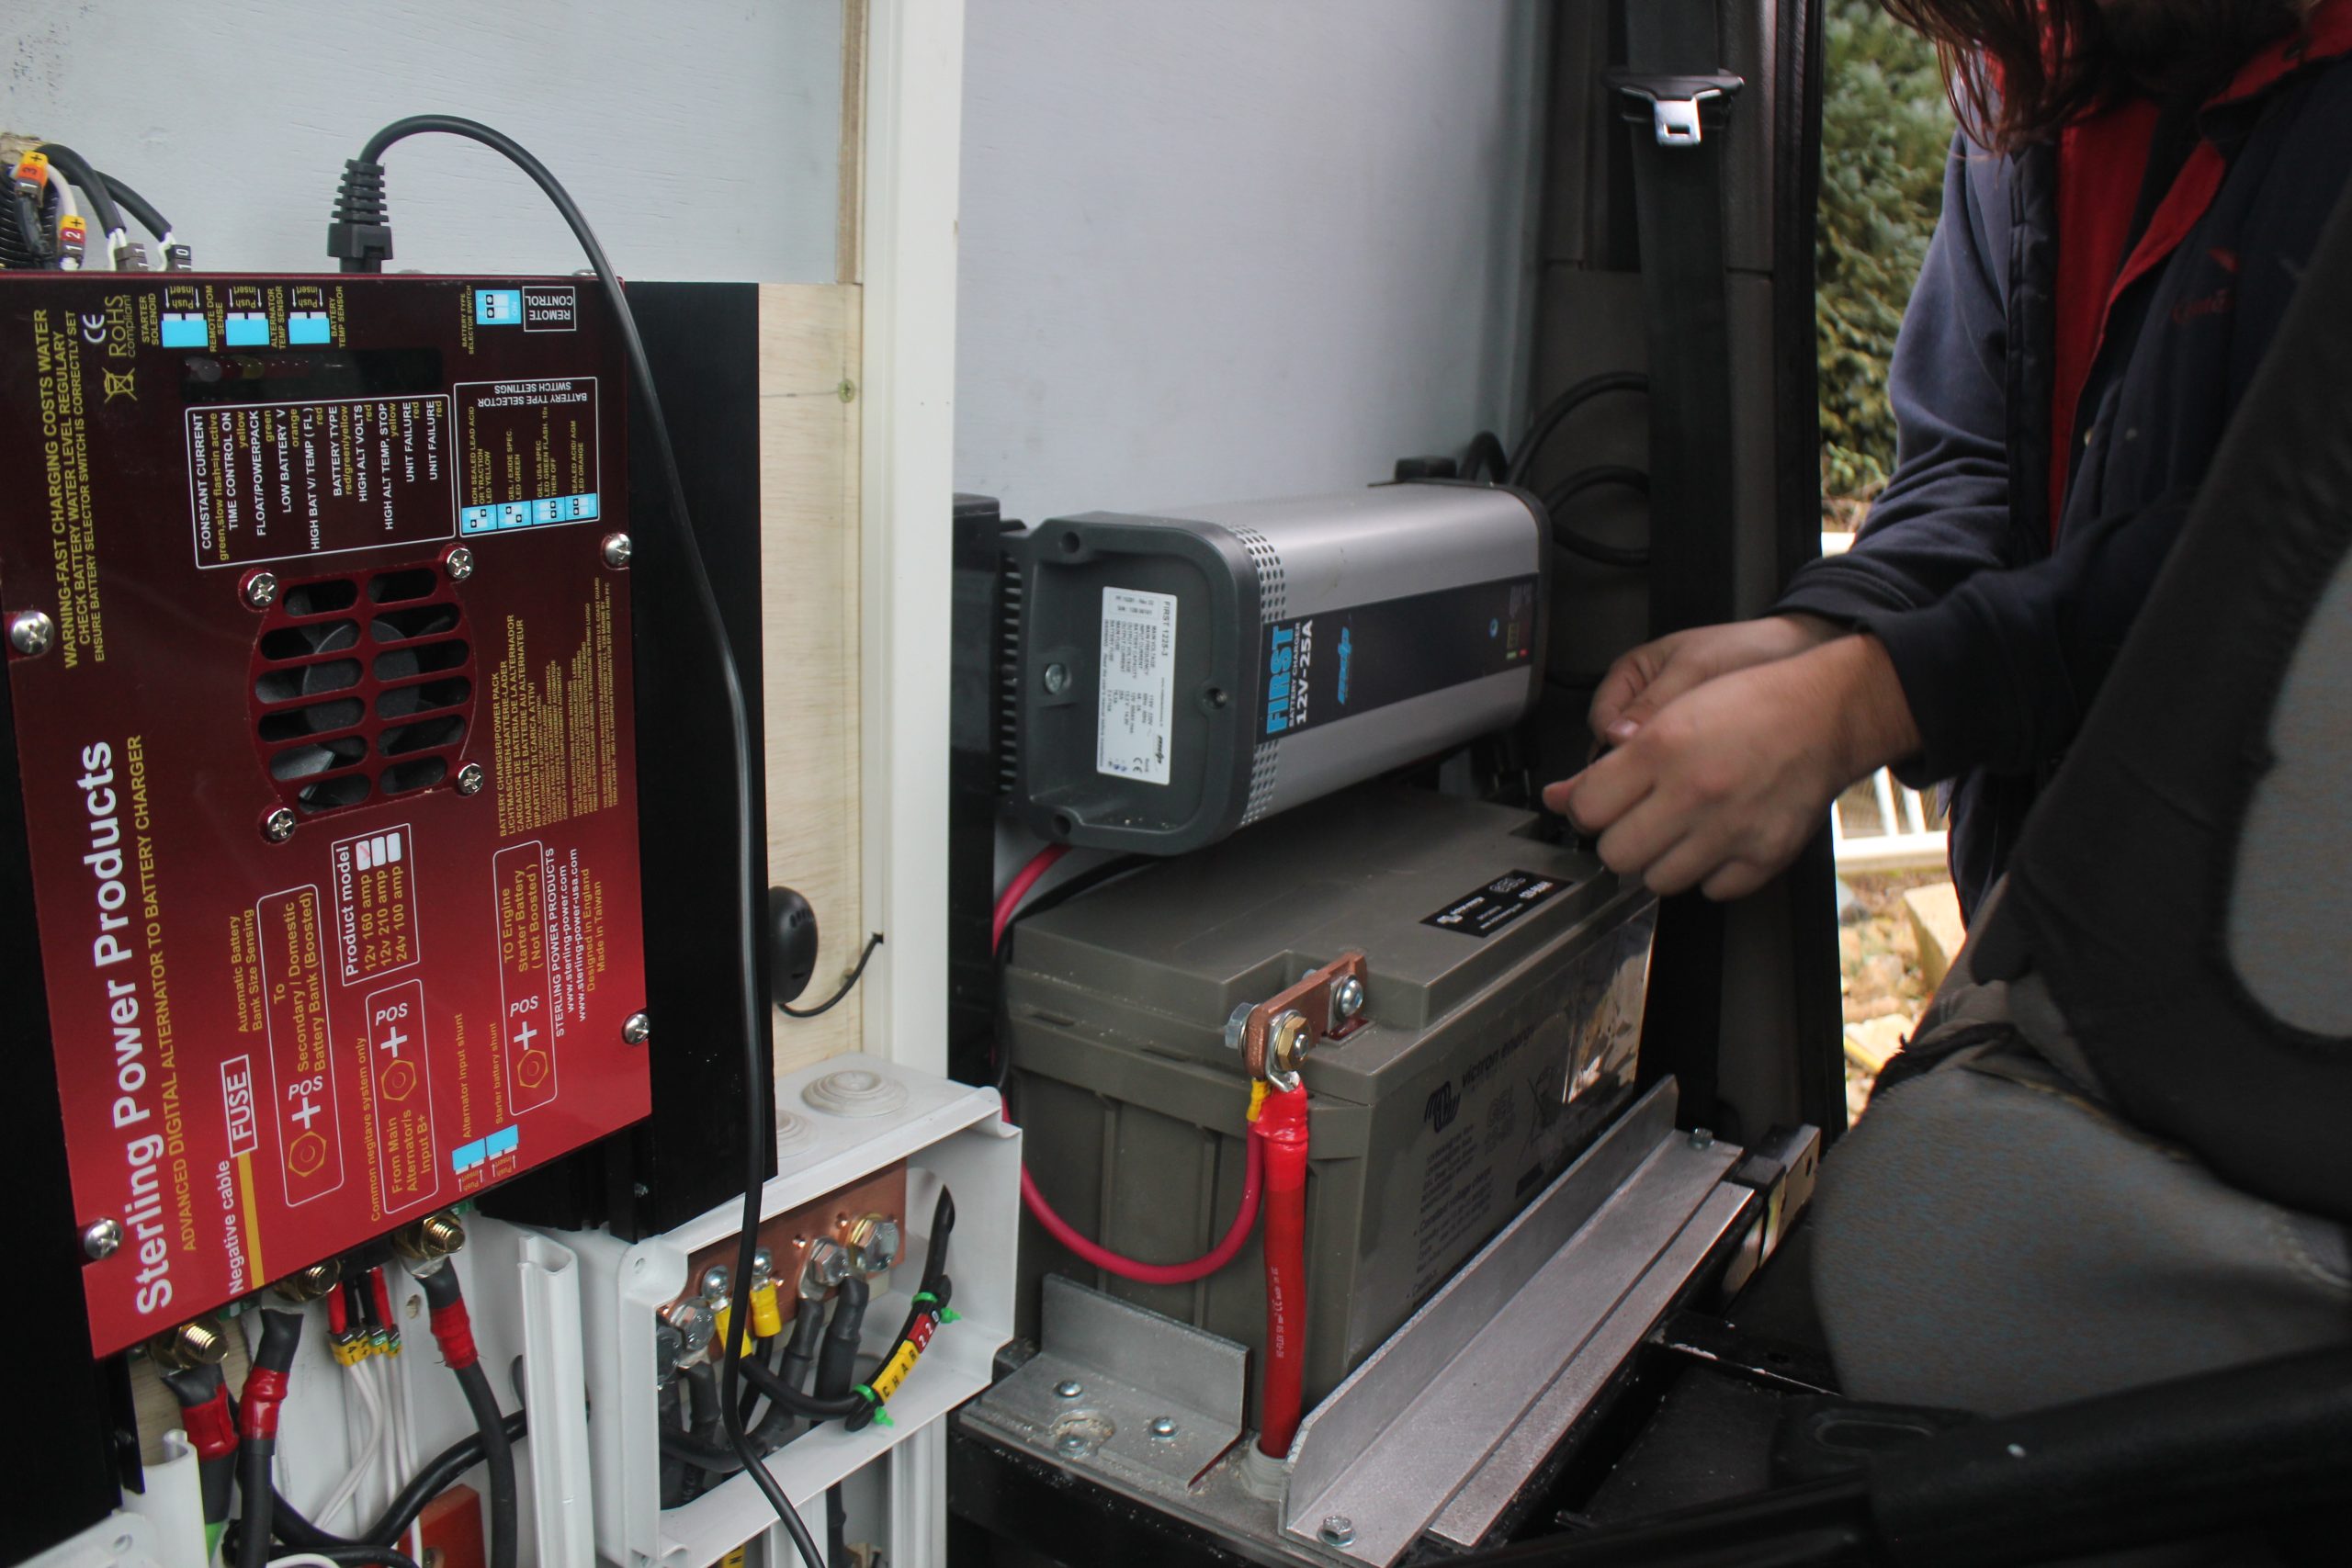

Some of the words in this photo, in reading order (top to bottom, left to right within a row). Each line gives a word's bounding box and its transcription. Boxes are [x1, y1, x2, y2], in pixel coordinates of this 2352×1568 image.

[139, 296, 151, 343] STARTER
[148, 293, 160, 345] SOLENOID
[205, 285, 215, 309] DOM
[215, 302, 225, 335] SENSE
[267, 288, 278, 348] ALTERNATOR
[275, 286, 285, 323] SENSOR
[525, 295, 574, 307] CONTROL
[528, 310, 571, 321] REMOTE
[33, 309, 51, 373] WATER
[65, 310, 77, 336] SET
[104, 295, 128, 356] RoHS
[121, 294, 136, 358] compliant
[206, 310, 217, 353] REMOTE
[277, 324, 287, 350] TEMP
[52, 331, 71, 414] REGULARY
[67, 338, 84, 415] CORRECTLY
[493, 383, 537, 395] SETTINGS
[538, 381, 571, 392] SWITCH
[39, 377, 57, 436] COSTS
[314, 407, 323, 425] red
[477, 396, 525, 408] SELECTOR
[526, 394, 548, 405] TYPE
[549, 392, 588, 403] BATTERY
[60, 417, 75, 466] LEVEL
[74, 418, 85, 431] IS
[192, 413, 207, 477] CURRENT
[209, 412, 220, 447] active
[221, 412, 232, 432] ON
[236, 411, 249, 448] yellow
[264, 410, 276, 443] green
[290, 408, 300, 447] orange
[302, 414, 313, 431] FL
[328, 405, 339, 439] TYPE
[75, 433, 89, 482] SWITCH
[223, 434, 236, 497] CONTROL
[249, 410, 266, 536] FLOAT/POWERPACK
[277, 423, 290, 481] BATTERY
[304, 440, 315, 475] TEMP
[330, 441, 343, 497] BATTERY
[340, 405, 354, 495] red/green/yellow
[469, 452, 478, 486] SEALED
[44, 441, 65, 535] CHARGING
[64, 468, 80, 522] WATER
[280, 484, 292, 513] LOW
[307, 491, 318, 517] BAT
[79, 484, 95, 551] SELECTOR
[197, 479, 212, 549] CONSTANT
[215, 499, 230, 561] green,slow
[227, 500, 239, 531] TIME
[309, 519, 320, 550] HIGH
[69, 525, 86, 591] BATTERY
[85, 554, 100, 610] BATTERY
[53, 538, 78, 669] WARNING-FAST
[74, 593, 91, 645] CHECK
[90, 611, 105, 662] ENSURE
[506, 615, 517, 682] ALTERNADOR
[1292, 621, 1300, 677] CHARGER
[492, 672, 500, 700] PACK
[510, 683, 518, 698] LA
[1266, 626, 1293, 734] FIRST
[1295, 620, 1313, 725] 12V-25A
[510, 699, 518, 714] DE
[1289, 679, 1297, 728] BATTERY
[492, 702, 504, 791] CHARGER/POWER
[500, 660, 516, 835] LICHTMASCHINEN-BATTERIE-LADER
[511, 715, 521, 759] BATERIA
[127, 735, 150, 830] CHARGER
[514, 760, 522, 774] DE
[497, 793, 507, 837] BATTERY
[514, 775, 525, 832] CARGADOR
[76, 741, 132, 967] Products
[137, 835, 159, 919] BATTERY
[335, 845, 353, 902] model
[360, 874, 373, 908] amp
[376, 870, 389, 904] amp
[391, 865, 404, 899] amp
[514, 870, 526, 921] Battery
[526, 873, 540, 933] Boosted
[545, 848, 558, 920] PRODUCTS
[580, 868, 593, 919] England
[594, 881, 603, 924] Taiwan
[146, 922, 162, 949] TO
[243, 908, 256, 964] Sensing
[299, 892, 320, 969] (Boosted)
[360, 912, 374, 940] 160
[377, 908, 390, 936] 210
[391, 903, 405, 931] 100
[501, 888, 514, 939] Engine
[570, 848, 586, 1022] www.sterling-power-usa.com
[583, 920, 593, 933] in
[594, 925, 604, 938] in
[230, 916, 243, 964] Battery
[283, 902, 300, 977] Domestic
[341, 905, 359, 977] Product
[364, 944, 377, 971] 12v
[379, 940, 392, 966] 12v
[395, 935, 408, 962] 24v
[503, 942, 514, 964] TO
[516, 925, 528, 973] Starter
[530, 934, 541, 961] Not
[549, 922, 560, 972] POWER
[559, 864, 575, 1013] www.sterling-power.com
[595, 940, 605, 973] Made
[248, 965, 259, 995] Size
[583, 935, 596, 992] Designed
[149, 950, 175, 1068] ALTERNATOR
[232, 965, 249, 1032] Automatic
[250, 997, 263, 1032] Bank
[273, 983, 286, 1005] To
[306, 972, 321, 1013] Bank
[375, 1002, 408, 1026] POS
[510, 995, 538, 1018] POS
[552, 974, 565, 1038] STERLING
[107, 979, 151, 1129] Power
[292, 990, 310, 1073] Secondary
[312, 1017, 326, 1072] Battery
[355, 1037, 368, 1064] only
[454, 1013, 465, 1047] shunt
[226, 1071, 253, 1142] FUSE
[288, 1075, 323, 1101] POS
[359, 1066, 372, 1111] system
[460, 1082, 472, 1138] Alternator
[161, 1071, 185, 1156] DIGITAL
[386, 1116, 400, 1153] Main
[416, 1114, 428, 1134] B+
[364, 1113, 377, 1165] negitave
[401, 1109, 418, 1191] Alternator/s
[418, 1135, 432, 1174] Input
[215, 1160, 234, 1210] cable
[368, 1167, 381, 1222] Common
[391, 1155, 403, 1194] From
[124, 1134, 173, 1314] Sterling
[173, 1157, 197, 1251] ADVANCED
[223, 1213, 245, 1295] Negative
